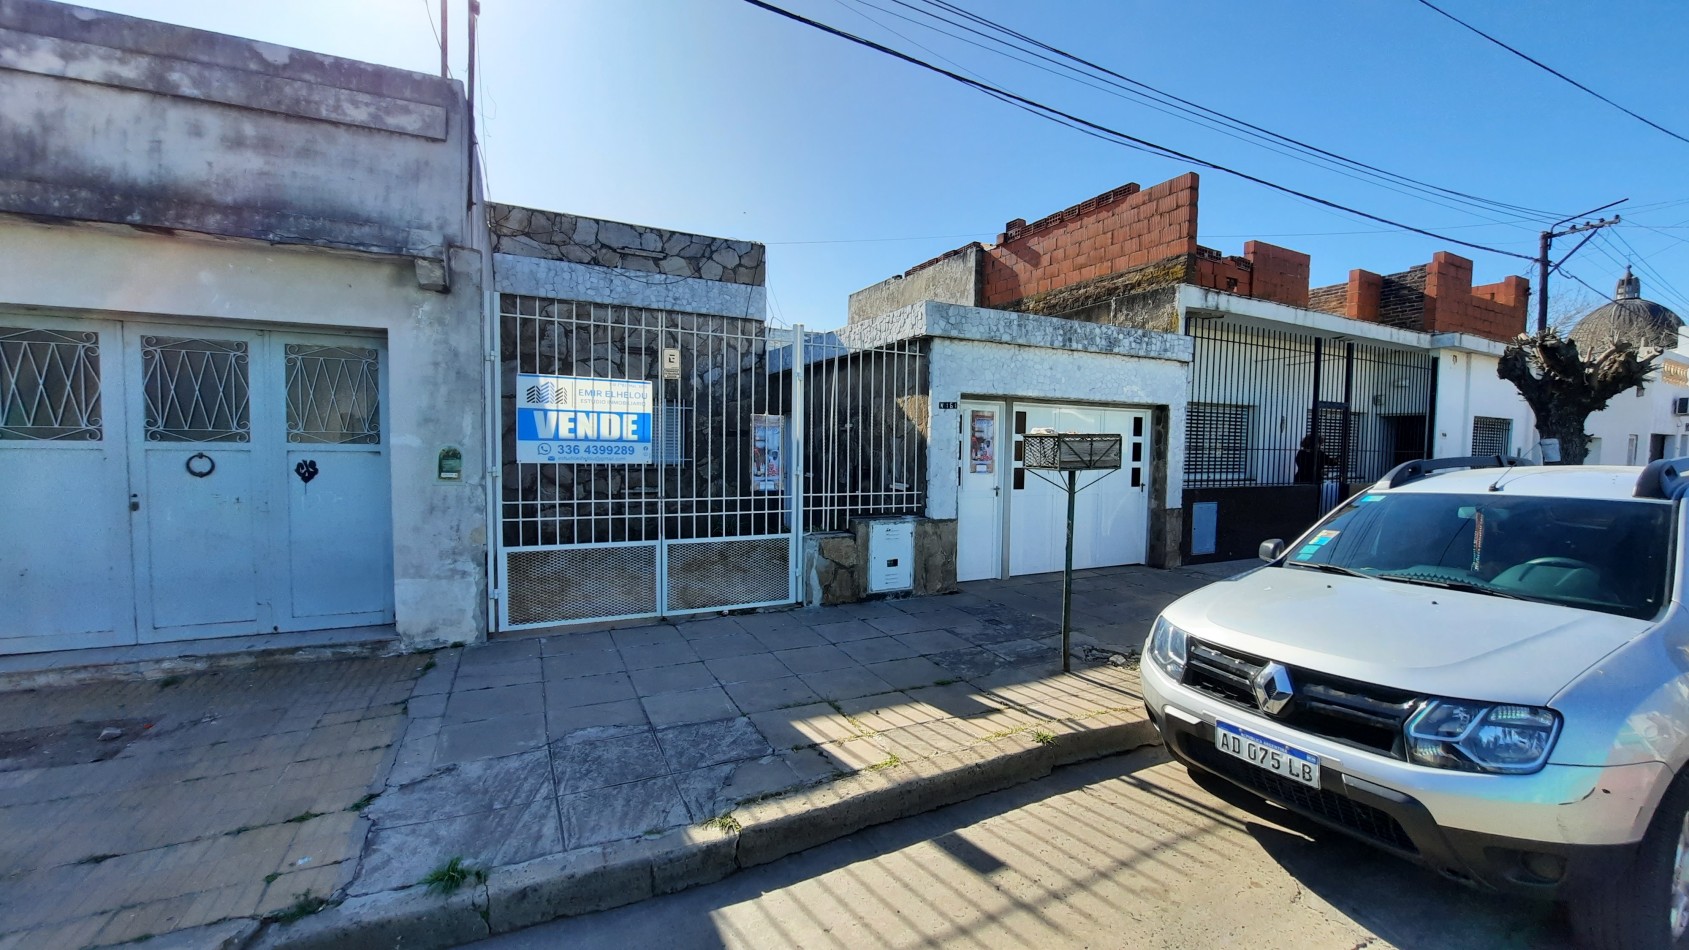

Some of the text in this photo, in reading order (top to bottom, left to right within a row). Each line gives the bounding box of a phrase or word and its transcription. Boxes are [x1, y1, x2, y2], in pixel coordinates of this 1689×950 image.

[579, 389, 647, 399] EMIR ELHELOU
[533, 410, 638, 440] VENDE
[557, 445, 635, 455] 336 4399289
[1221, 733, 1313, 782] AD 075 LB
